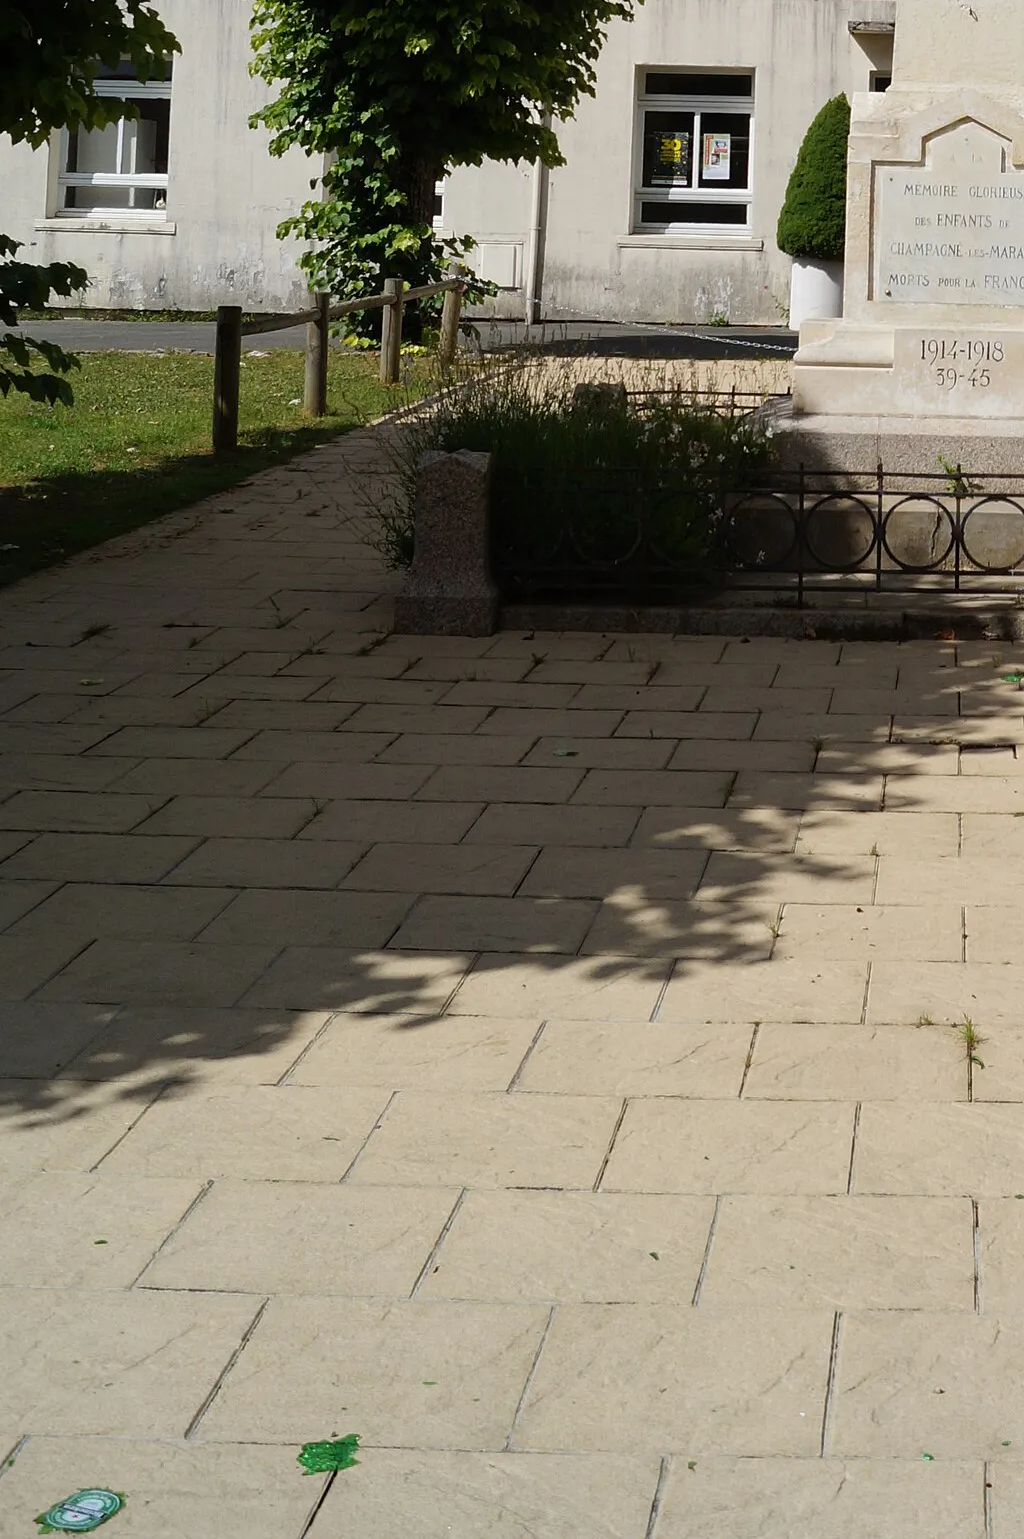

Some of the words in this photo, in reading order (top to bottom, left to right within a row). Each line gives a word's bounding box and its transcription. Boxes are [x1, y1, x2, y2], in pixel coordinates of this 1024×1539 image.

[904, 182, 958, 197] MÉMOIRE
[914, 216, 931, 227] DES
[936, 214, 992, 229] ENFANTS
[999, 219, 1010, 228] DE
[888, 274, 930, 287] MORTS
[938, 278, 960, 287] POUR
[965, 279, 976, 288] LA
[920, 339, 1004, 366] 1914-1918
[935, 368, 991, 391] 39-45
